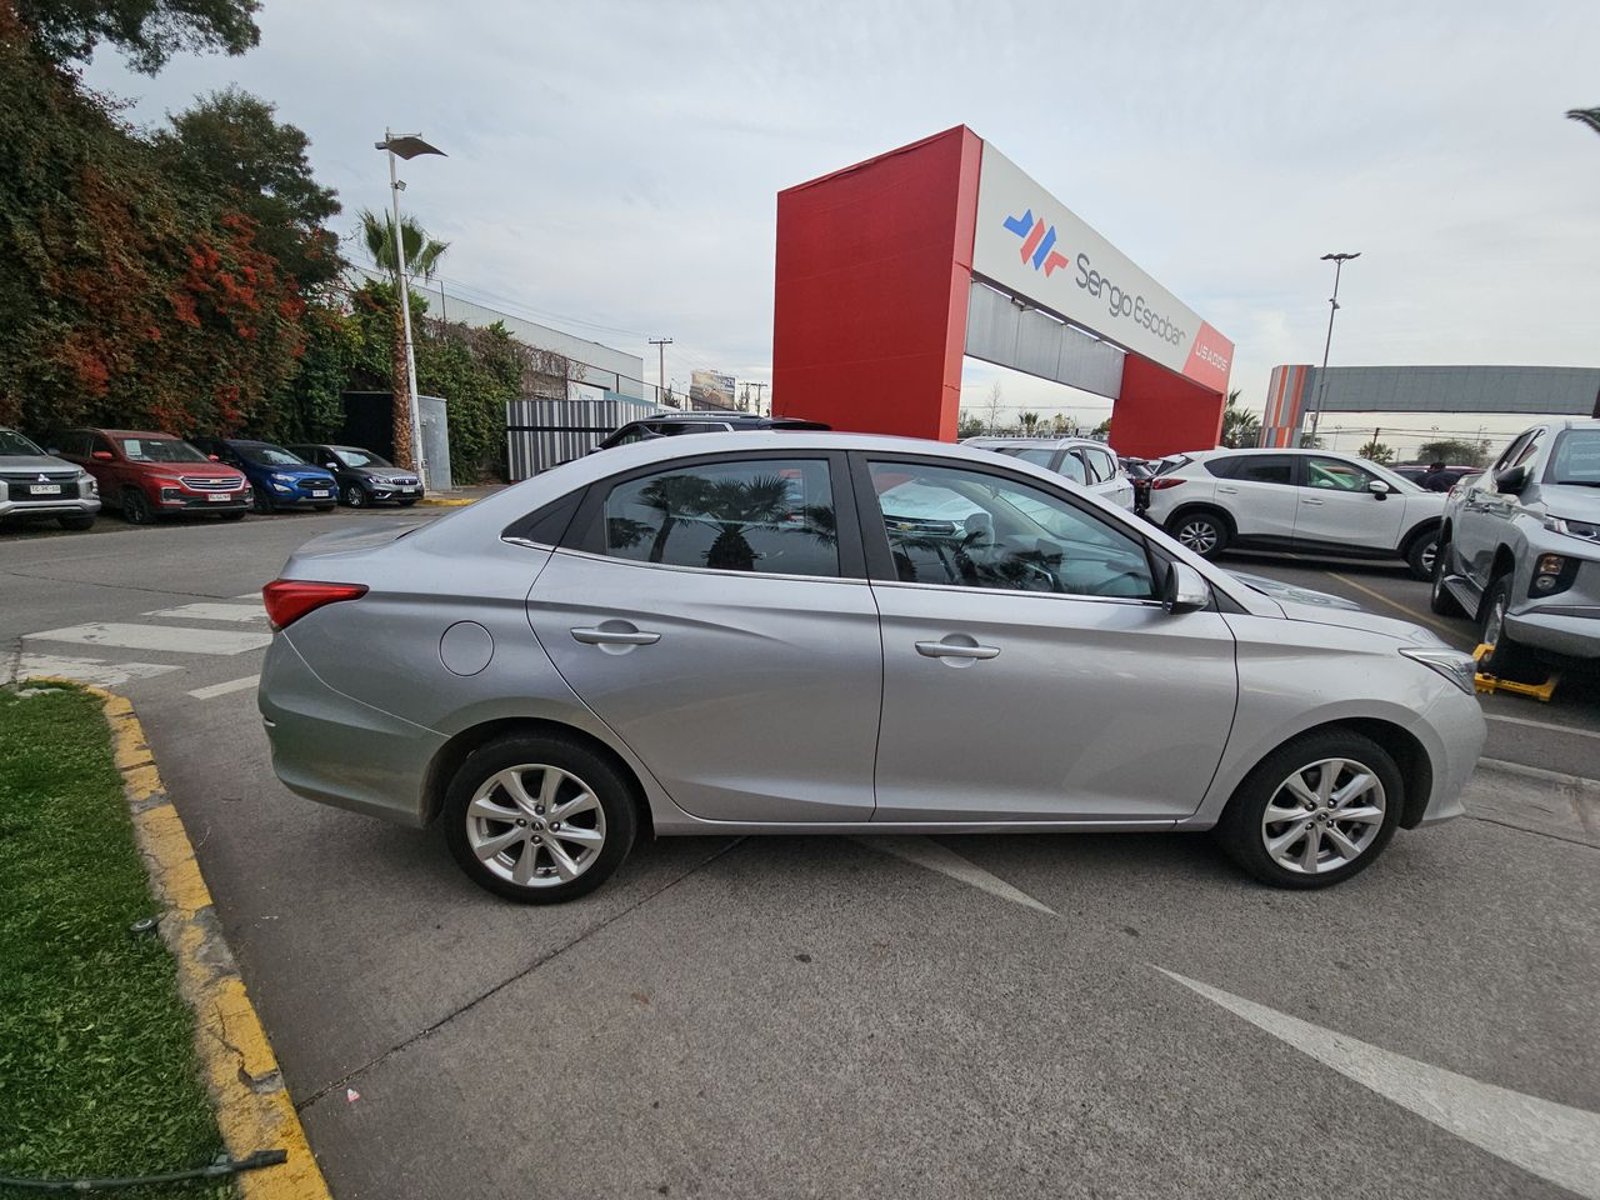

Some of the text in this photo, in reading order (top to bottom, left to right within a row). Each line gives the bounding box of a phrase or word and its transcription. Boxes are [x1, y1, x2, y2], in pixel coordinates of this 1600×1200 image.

[1075, 252, 1186, 346] Sergio Escobar
[1194, 342, 1228, 372] USADOS
